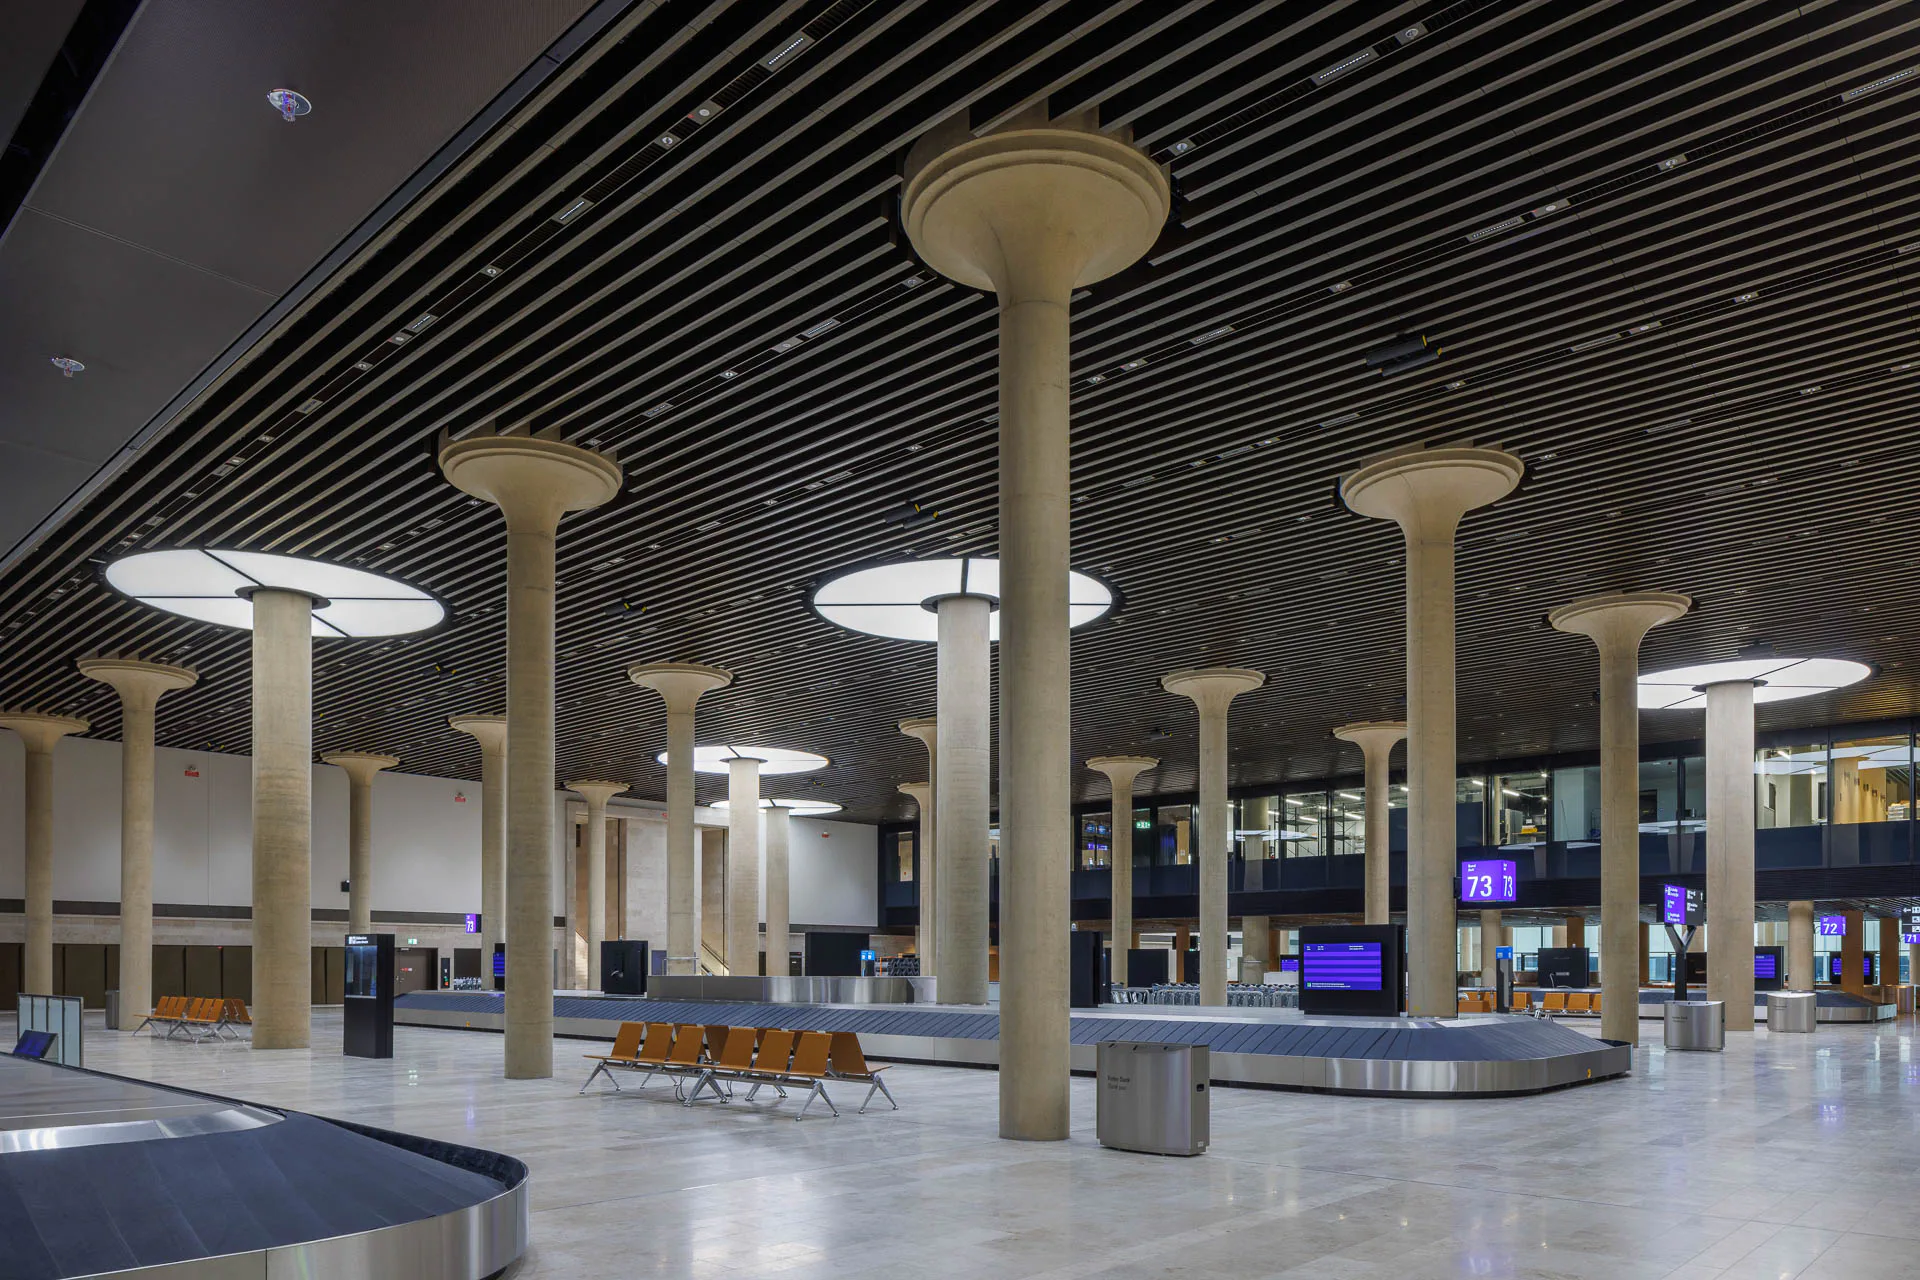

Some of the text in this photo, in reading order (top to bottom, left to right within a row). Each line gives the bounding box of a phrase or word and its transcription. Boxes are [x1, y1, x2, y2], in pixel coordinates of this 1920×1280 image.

[1467, 875, 1492, 897] 73
[1503, 875, 1513, 898] 73
[466, 920, 474, 932] 73
[1823, 923, 1838, 934] 72
[1906, 934, 1917, 943] 71
